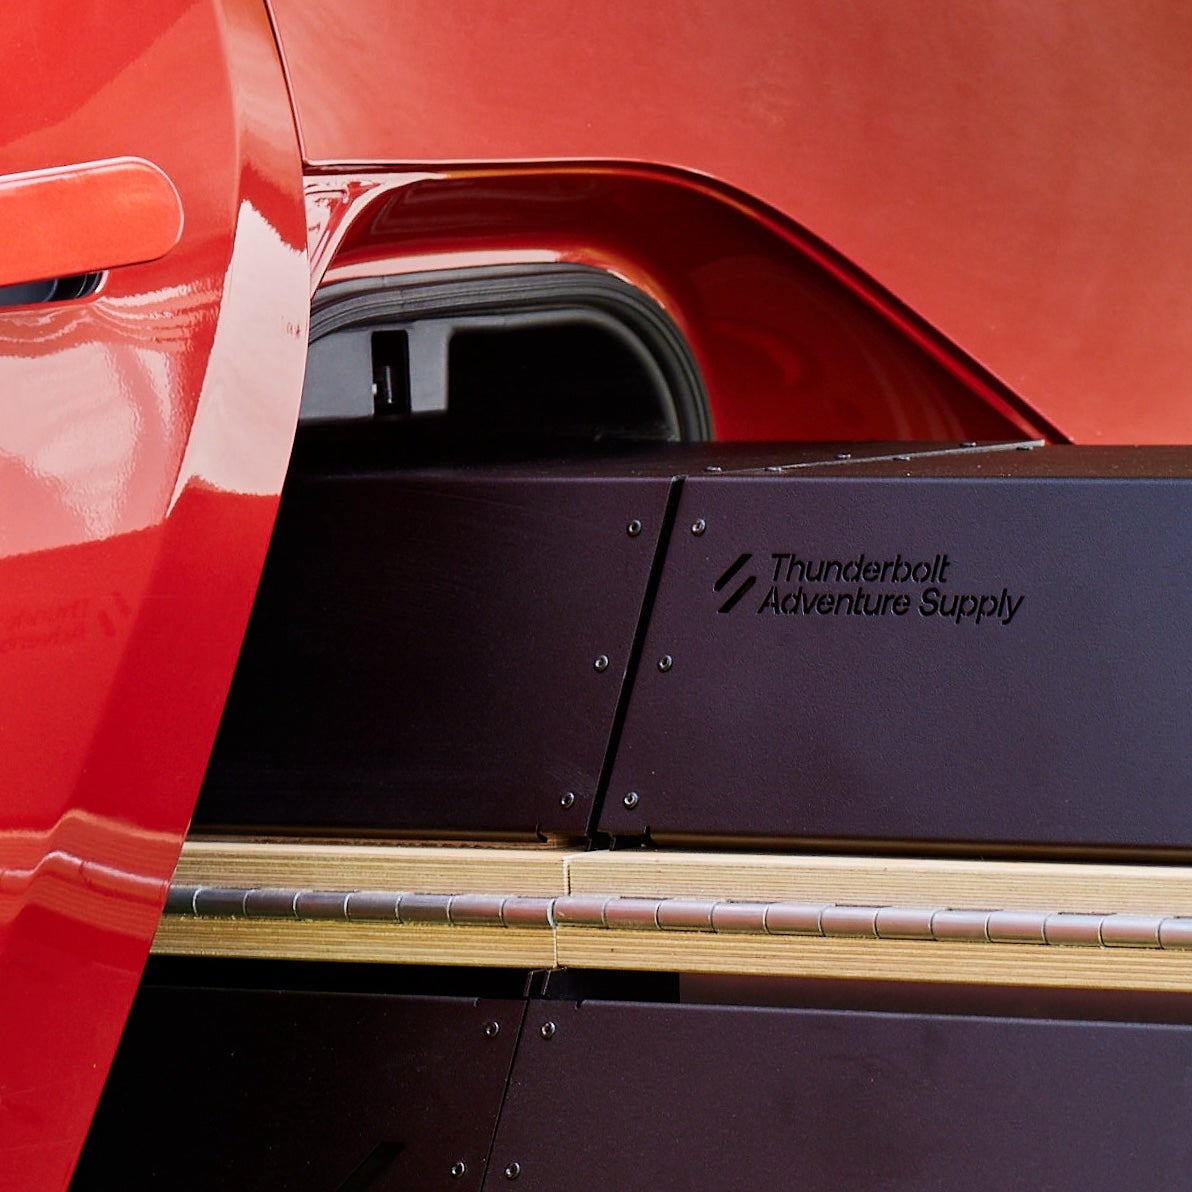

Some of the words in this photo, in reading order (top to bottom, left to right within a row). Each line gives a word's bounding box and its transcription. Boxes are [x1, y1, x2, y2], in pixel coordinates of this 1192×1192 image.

[771, 553, 950, 583] Thunderbolt
[756, 586, 911, 616] Adventure
[917, 586, 1025, 626] Supply
